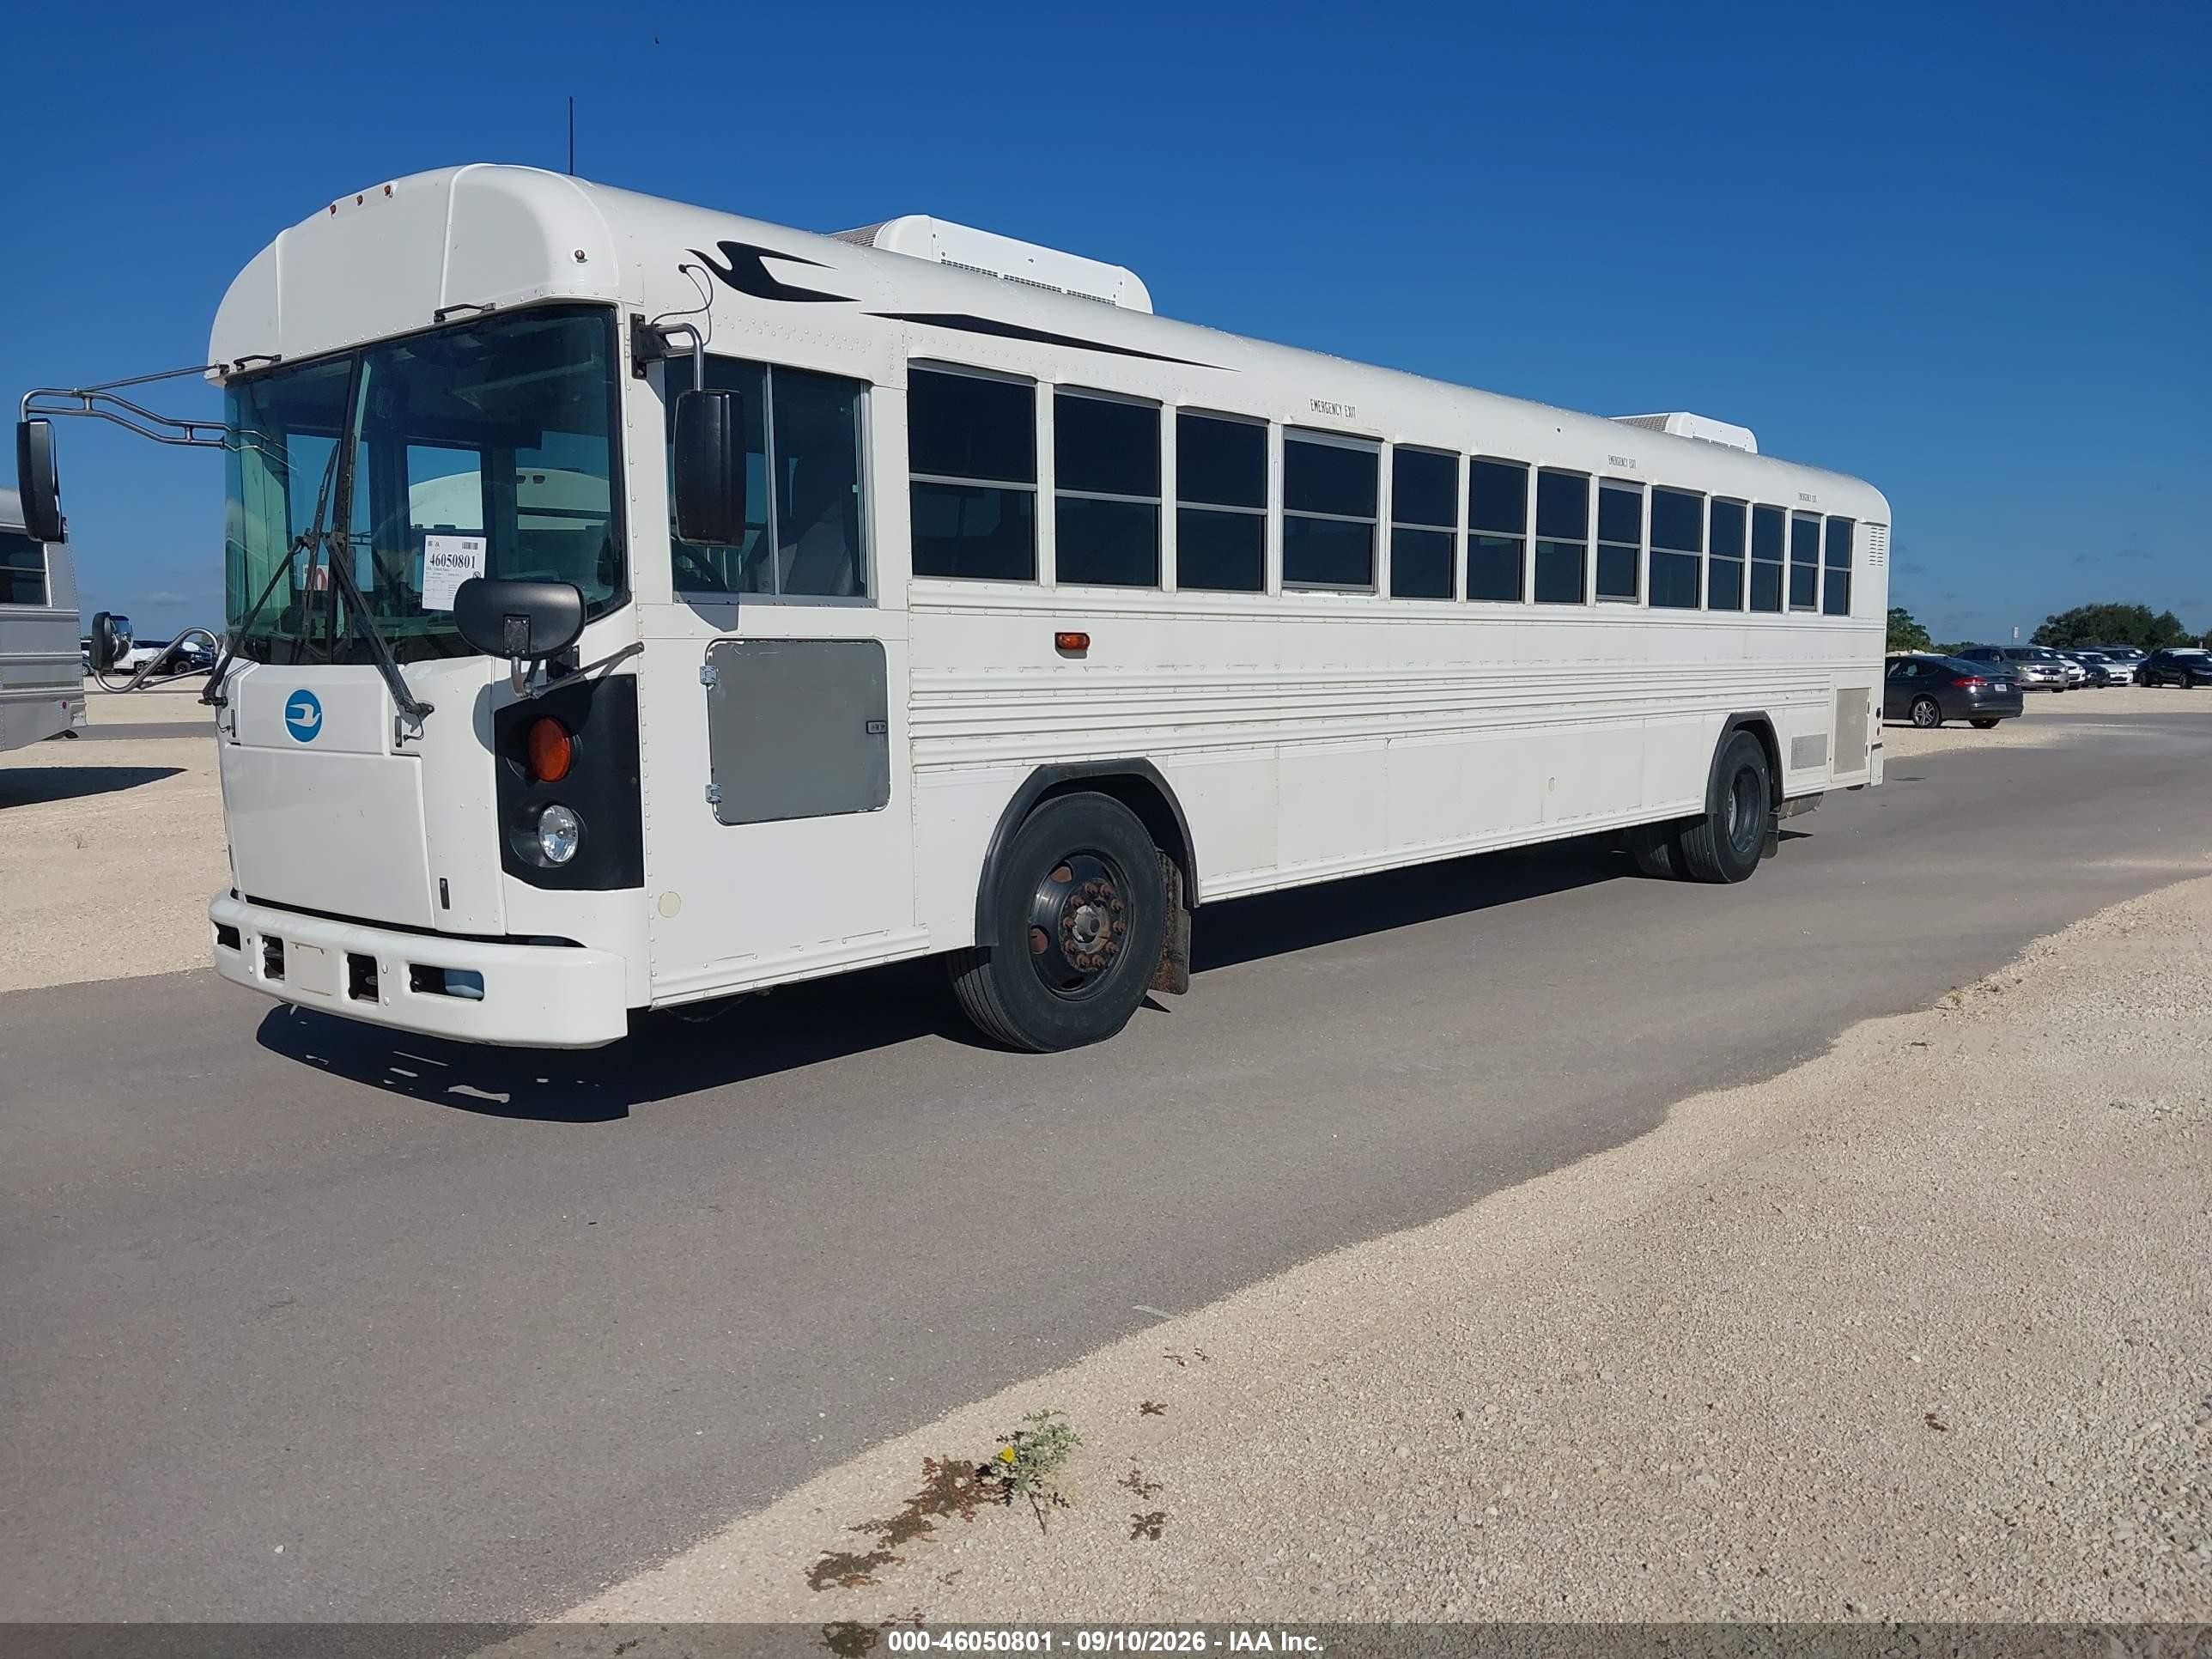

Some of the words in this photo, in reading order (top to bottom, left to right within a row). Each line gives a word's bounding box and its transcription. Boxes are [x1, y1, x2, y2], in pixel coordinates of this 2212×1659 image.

[1310, 398, 1342, 416] EMERGENCY
[1344, 404, 1357, 419] EXIT
[429, 552, 476, 569] 46050801
